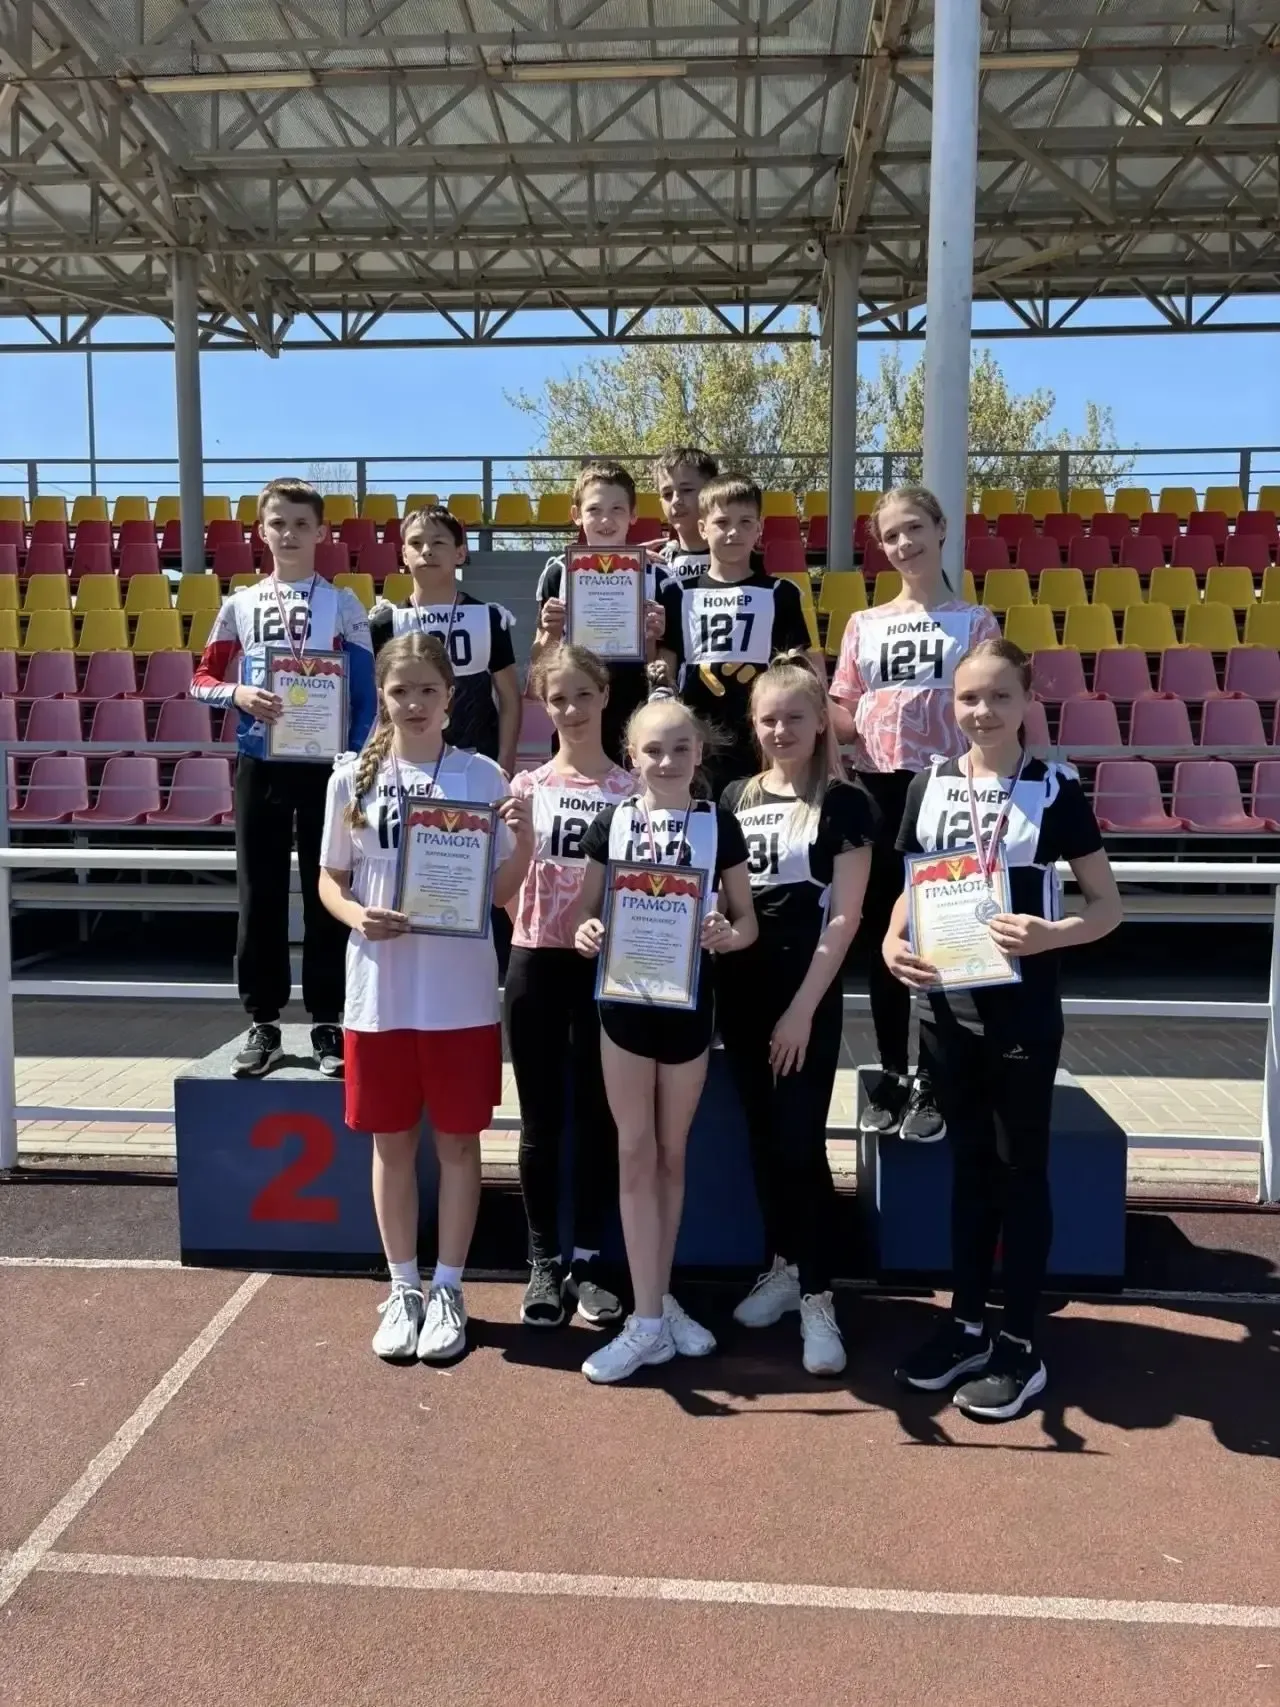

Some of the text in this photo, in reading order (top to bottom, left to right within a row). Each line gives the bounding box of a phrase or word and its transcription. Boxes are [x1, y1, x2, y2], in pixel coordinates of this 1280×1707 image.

[579, 575, 633, 586] ГРАМОТА
[260, 590, 309, 601] НОМЕР
[703, 595, 752, 607] НОМЕР
[700, 613, 755, 652] 127
[887, 621, 941, 635] НОМЕР
[880, 639, 944, 682] 124
[280, 677, 335, 689] ГРАМОТА
[947, 788, 1009, 804] НОМЕР
[560, 797, 613, 812] НОМЕ
[416, 831, 480, 848] ГРАМОТА
[622, 896, 687, 914] ГРАМОТА
[250, 1112, 338, 1222] 2
